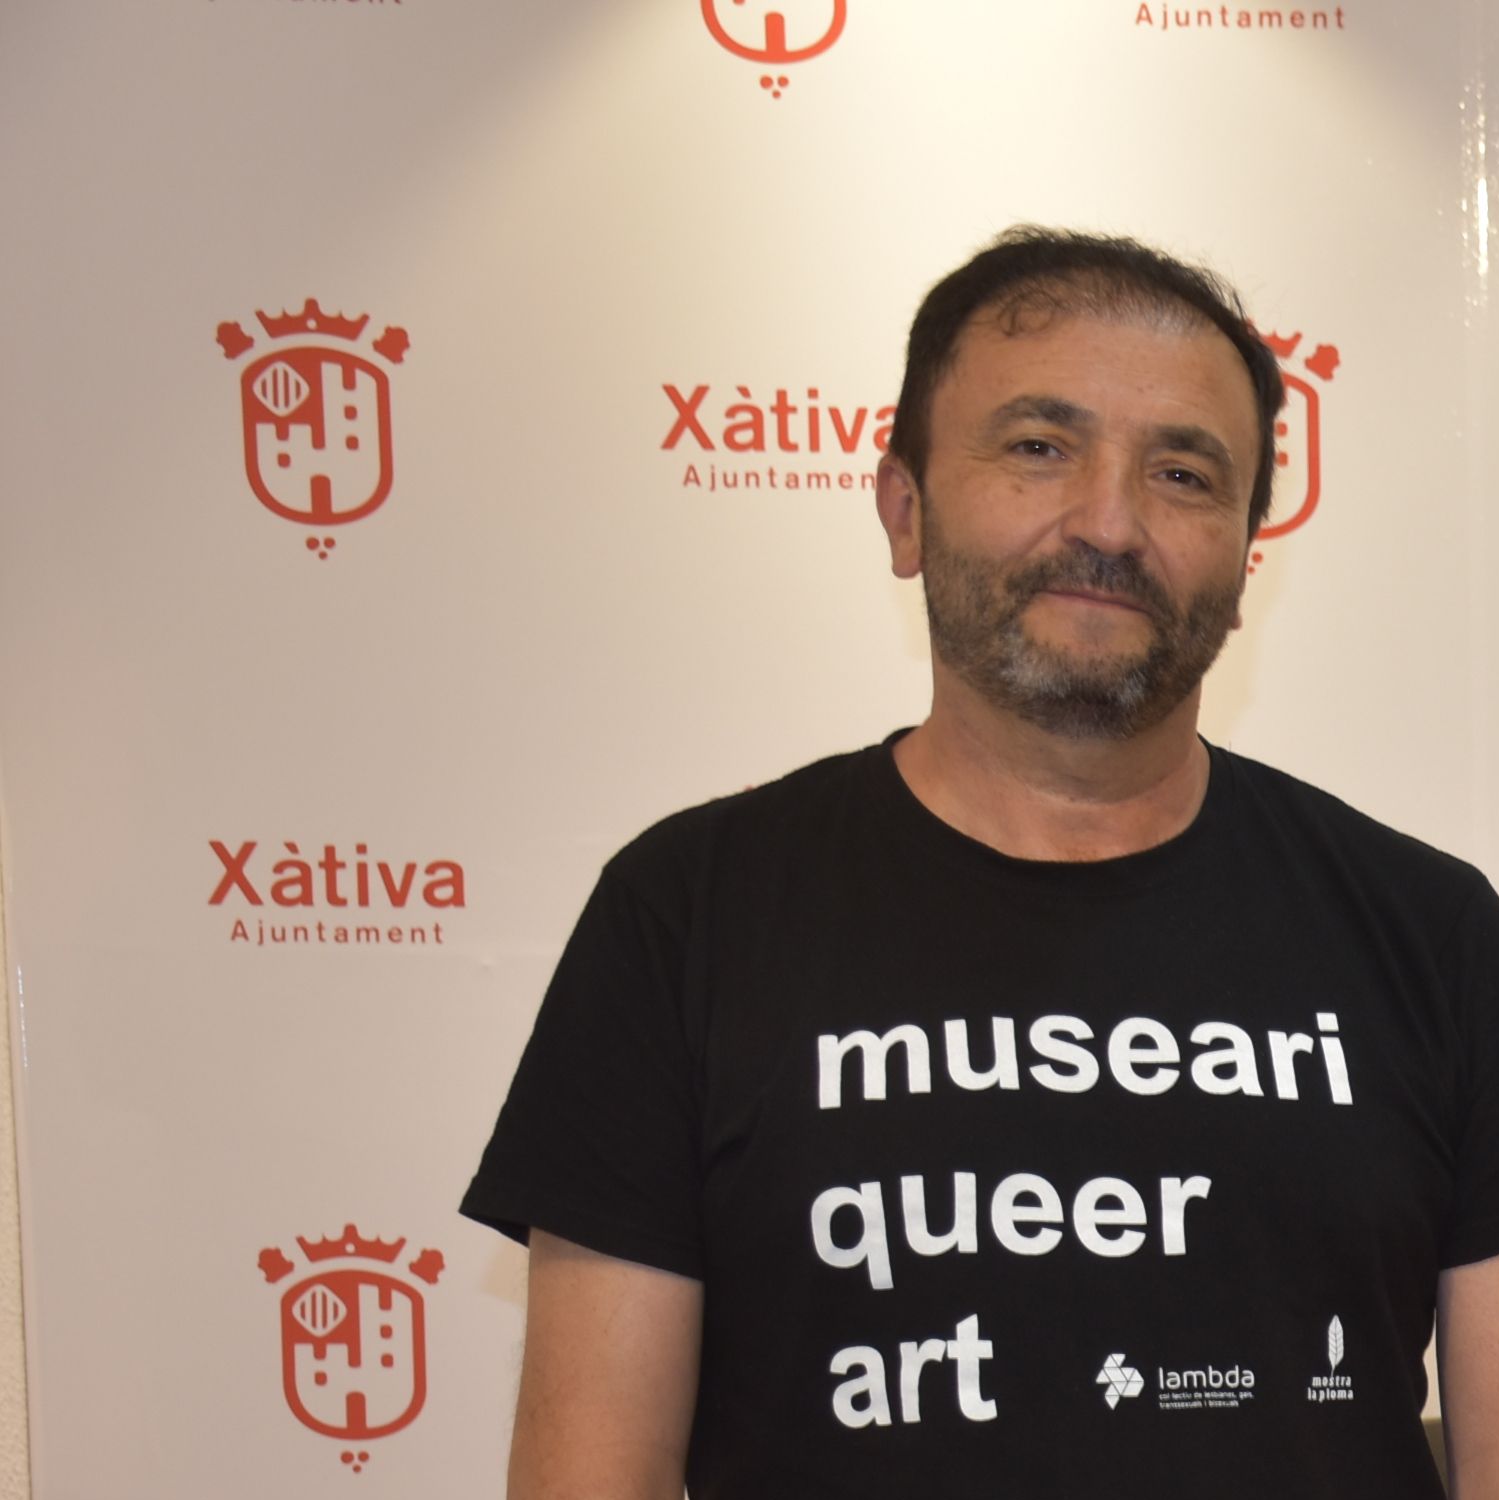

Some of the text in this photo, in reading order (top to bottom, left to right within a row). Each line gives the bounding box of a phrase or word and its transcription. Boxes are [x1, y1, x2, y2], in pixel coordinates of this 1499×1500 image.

[1135, 2, 1345, 31] Ajuntament
[683, 464, 876, 492] Ajuntamen
[208, 840, 465, 908] Xàtiva
[231, 919, 443, 946] Ajuntament
[818, 1012, 1353, 1109] museari
[811, 1172, 1211, 1290] queer
[830, 1314, 997, 1428] art
[1158, 1364, 1255, 1390] lambda
[1312, 1376, 1352, 1387] mostra
[1307, 1388, 1354, 1403] la ploma
